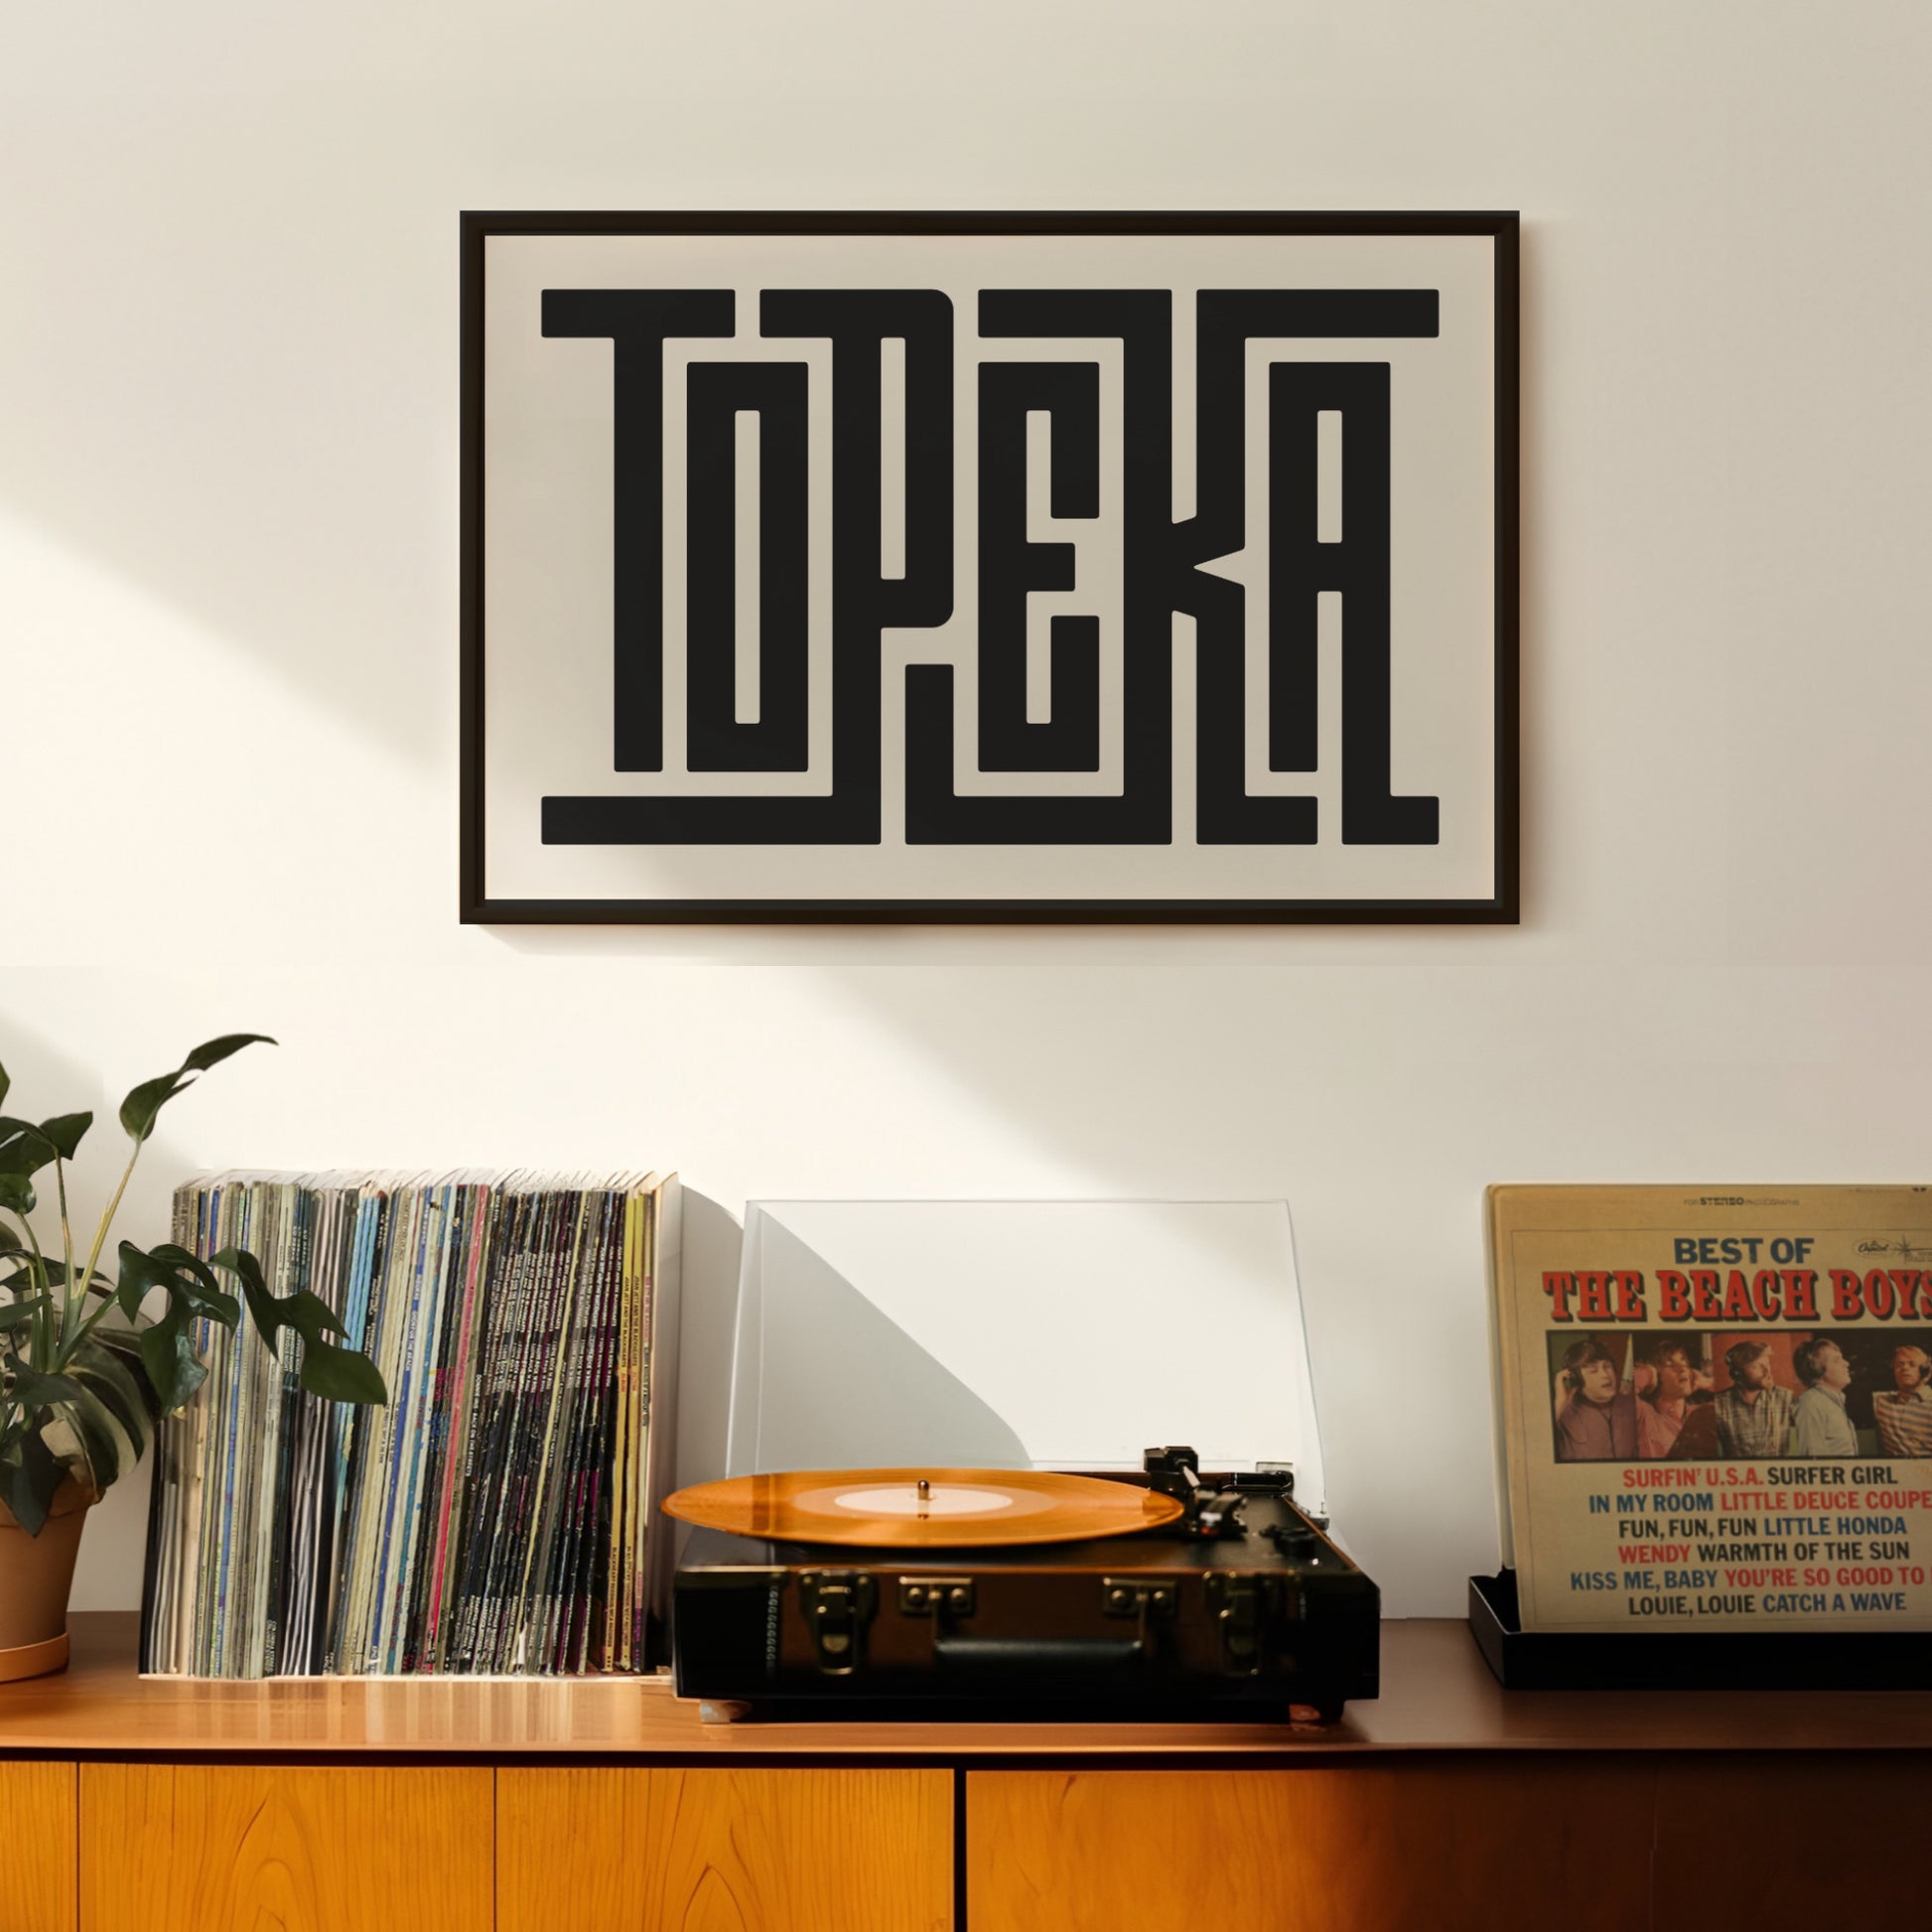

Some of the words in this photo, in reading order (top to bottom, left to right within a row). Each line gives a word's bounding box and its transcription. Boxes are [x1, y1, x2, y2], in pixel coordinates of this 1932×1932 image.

[541, 289, 1440, 845] TOPEKA
[1675, 1238, 1764, 1265] BEST
[1770, 1237, 1815, 1264] OF
[1543, 1271, 1648, 1322] THE
[1656, 1269, 1821, 1321] BEACH
[1830, 1269, 1932, 1321] BOYS
[1623, 1468, 1702, 1488] SURFIN'
[1707, 1467, 1764, 1486] U.S.A.
[1768, 1466, 1846, 1485] SURFER
[1852, 1466, 1898, 1484] GIRL
[1589, 1495, 1610, 1513] IN
[1616, 1494, 1647, 1513] MY
[1654, 1493, 1714, 1512] ROOM
[1722, 1492, 1788, 1510] LITTLE
[1794, 1491, 1860, 1510] DEUCE
[1864, 1490, 1932, 1509] COUPE
[1619, 1519, 1665, 1540] FUN,
[1669, 1519, 1714, 1540] FUN,
[1719, 1518, 1756, 1536] FUN
[1765, 1517, 1831, 1535] LITTLE
[1838, 1517, 1907, 1535] HONDA
[1618, 1545, 1690, 1564] WENDY
[1698, 1543, 1788, 1562] WARMTH
[1794, 1543, 1820, 1561] OF
[1824, 1543, 1863, 1561] THE
[1869, 1542, 1910, 1560] SUN
[1571, 1572, 1617, 1590] KISS
[1624, 1571, 1661, 1592] ME,
[1665, 1570, 1719, 1589] BABY
[1725, 1569, 1798, 1588] YOU'RE
[1804, 1568, 1831, 1587] SO
[1837, 1568, 1892, 1586] GOOD
[1898, 1568, 1925, 1586] TO
[1629, 1596, 1694, 1617] LOUIE,
[1698, 1595, 1755, 1614] LOUIE
[1763, 1593, 1827, 1612] CATCH
[1833, 1593, 1846, 1610] A
[1850, 1592, 1907, 1611] WAVE
